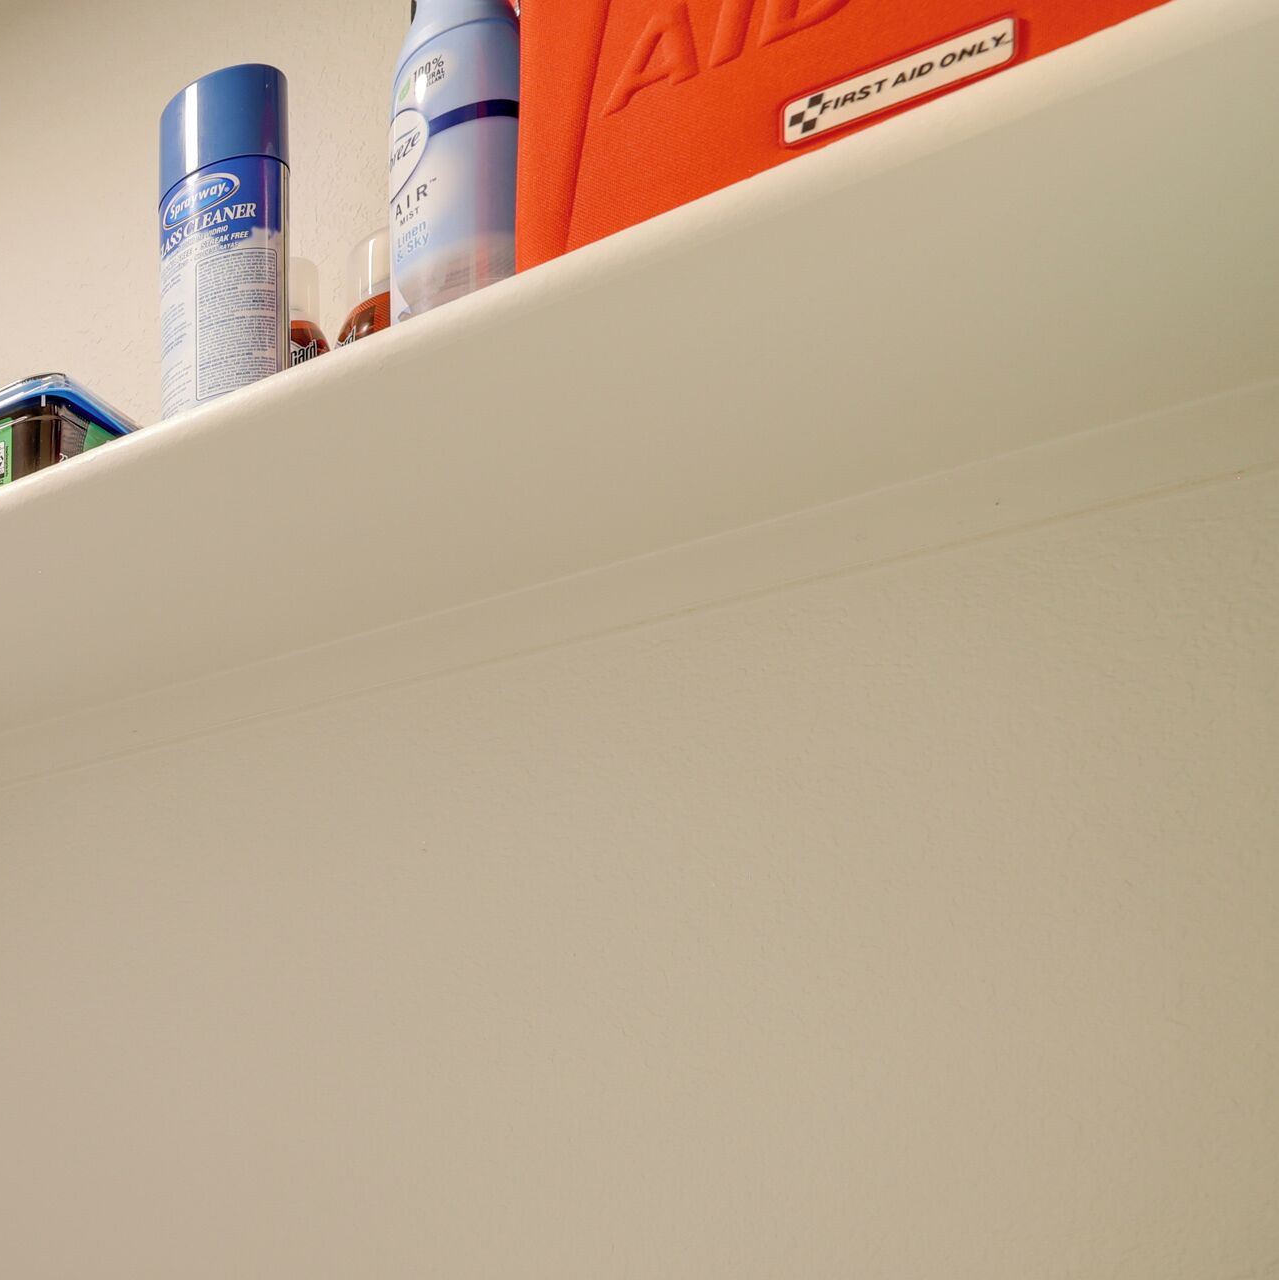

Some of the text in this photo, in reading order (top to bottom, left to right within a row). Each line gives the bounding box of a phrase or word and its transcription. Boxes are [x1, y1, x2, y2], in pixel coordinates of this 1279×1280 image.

[819, 32, 1007, 115] FIRST AID ONLY
[170, 182, 227, 219] Sprayway
[183, 203, 256, 237] CLEANER
[399, 207, 420, 227] MIST
[230, 231, 249, 240] FREE
[398, 221, 426, 247] Linen
[407, 232, 429, 254] Sky
